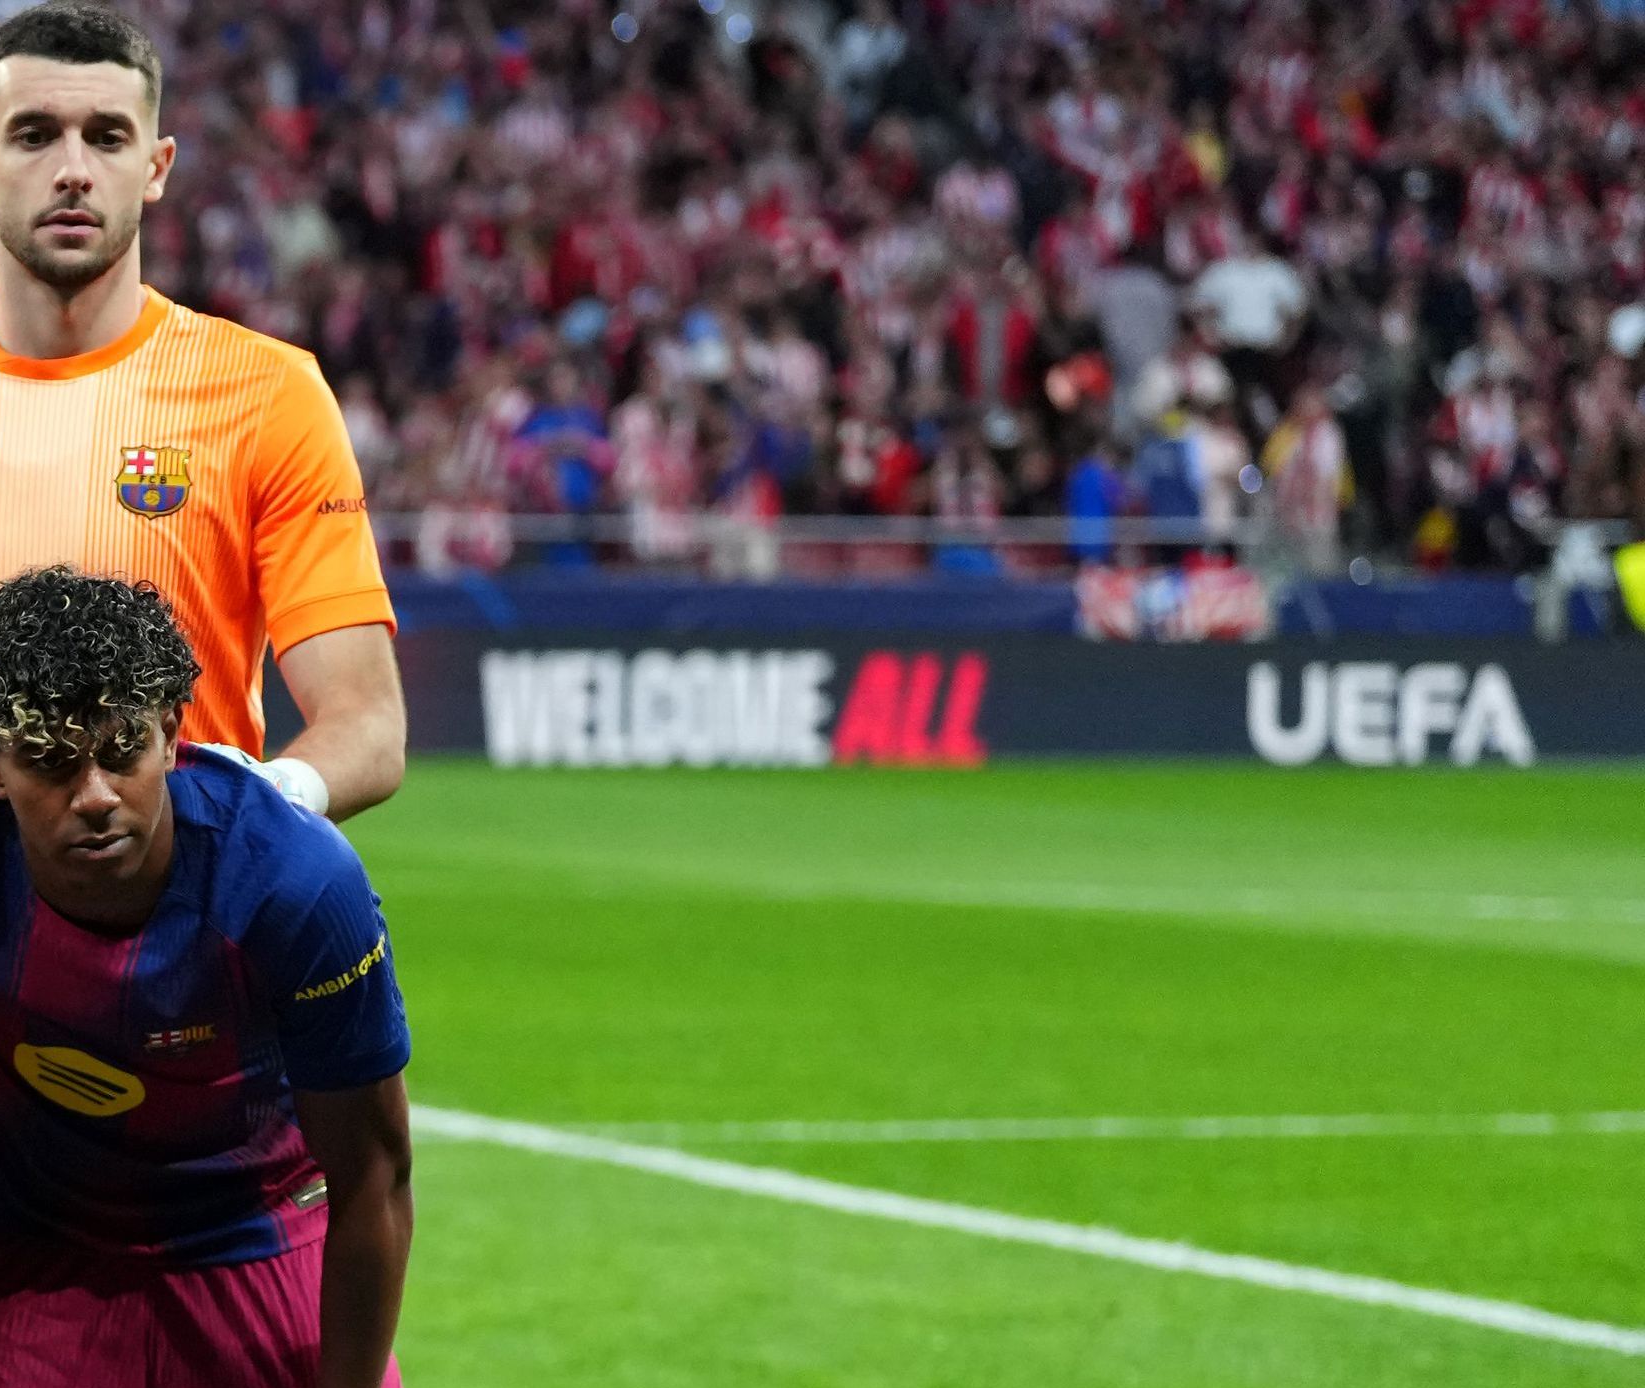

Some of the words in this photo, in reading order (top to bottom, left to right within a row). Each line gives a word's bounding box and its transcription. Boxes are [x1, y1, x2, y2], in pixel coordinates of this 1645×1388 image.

[140, 475, 166, 484] FCB
[480, 650, 835, 768] WELCOME
[833, 651, 988, 767] ALL
[1247, 661, 1536, 768] UEFA
[293, 935, 386, 1001] AMBILIGHT
